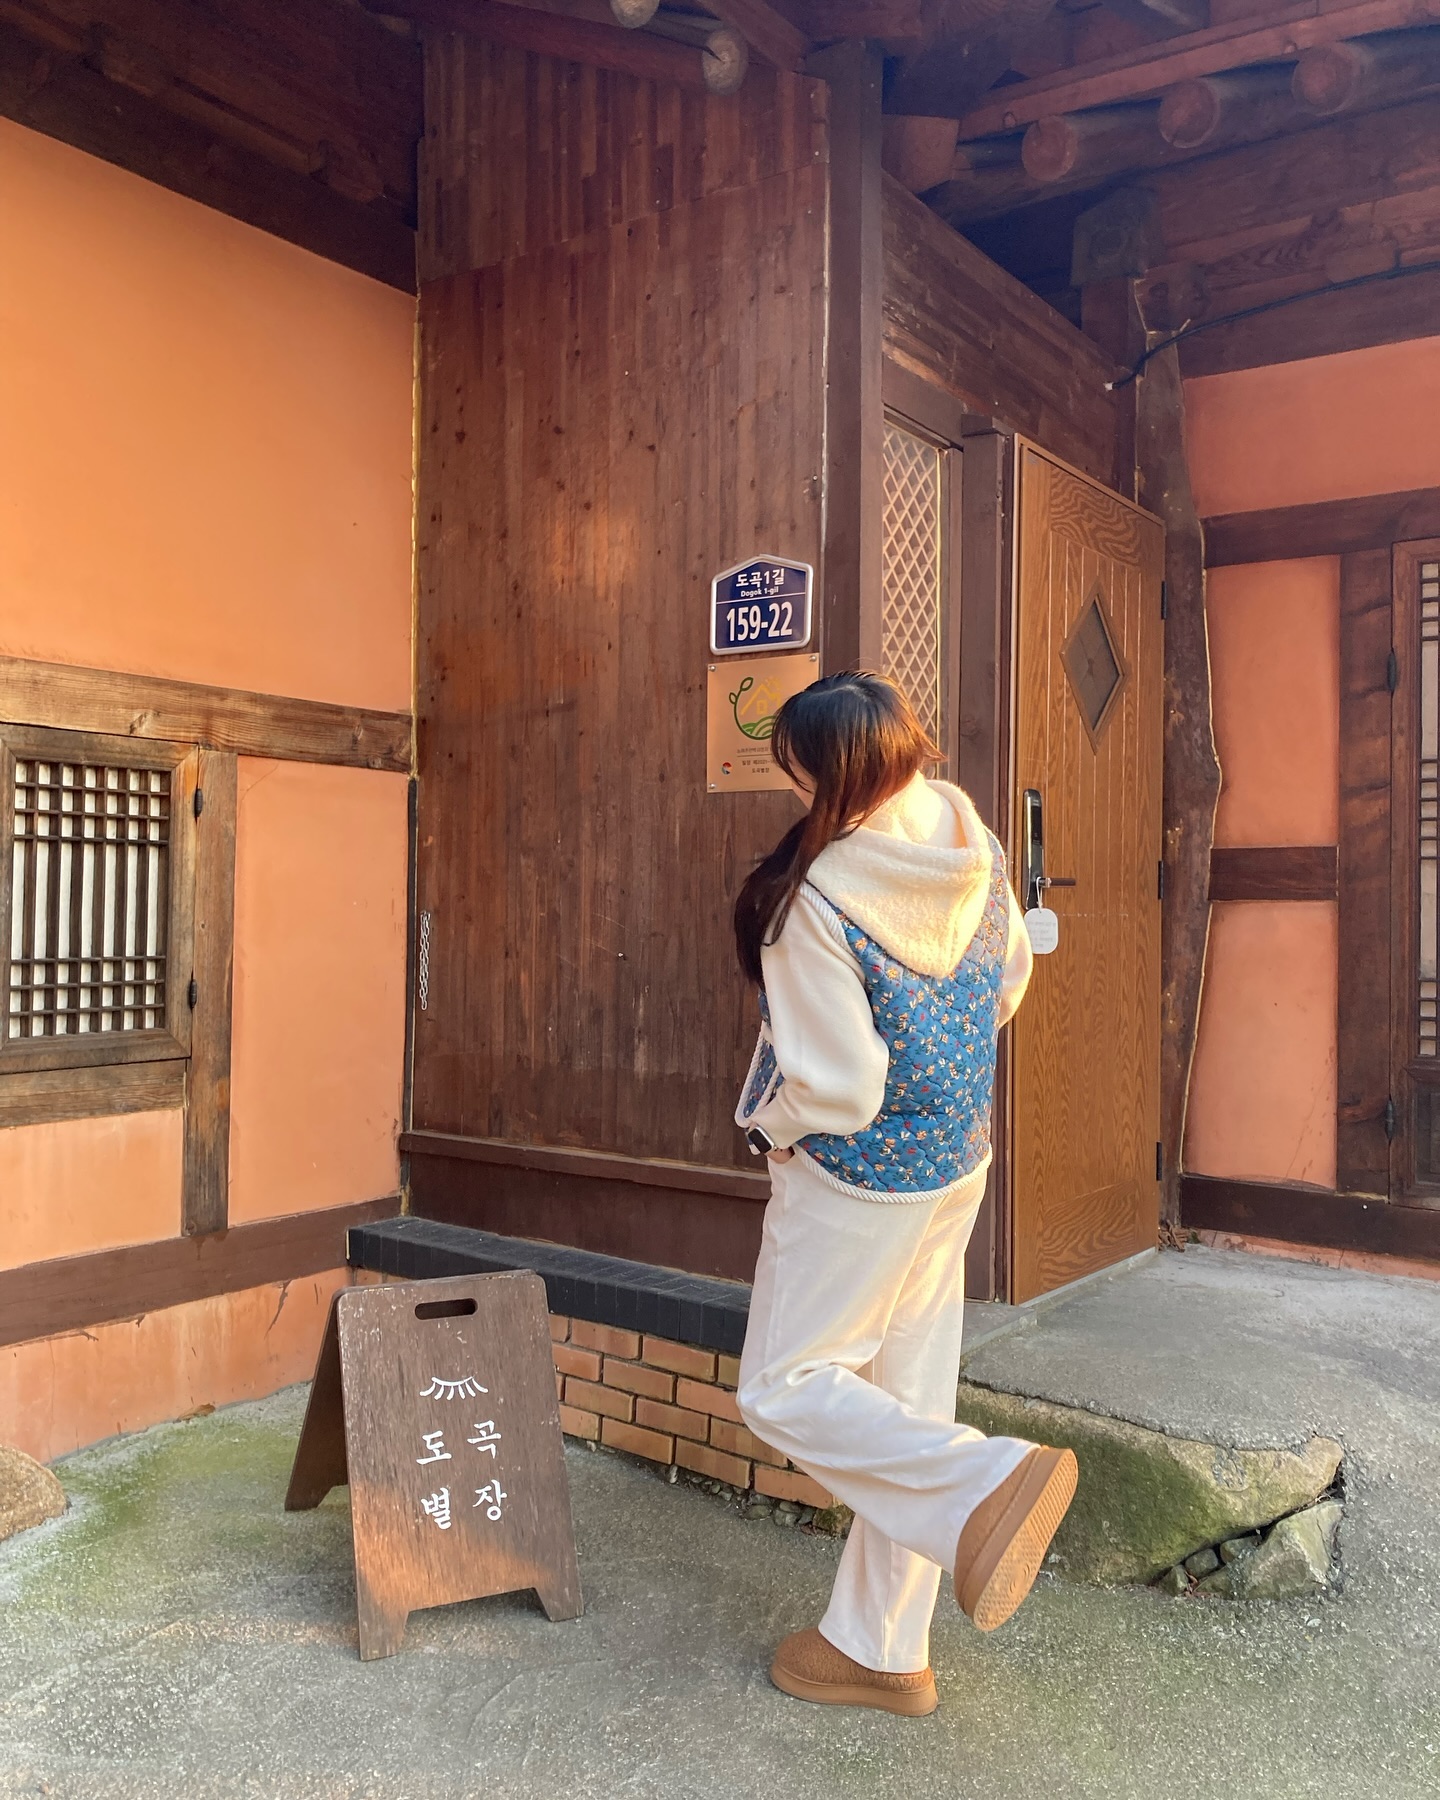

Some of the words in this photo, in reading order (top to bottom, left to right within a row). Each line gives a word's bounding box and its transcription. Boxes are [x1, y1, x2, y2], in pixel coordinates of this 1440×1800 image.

[736, 568, 785, 588] 도곡1길
[740, 588, 762, 597] Dogok
[763, 586, 779, 596] 1-gil
[726, 601, 793, 641] 159-22
